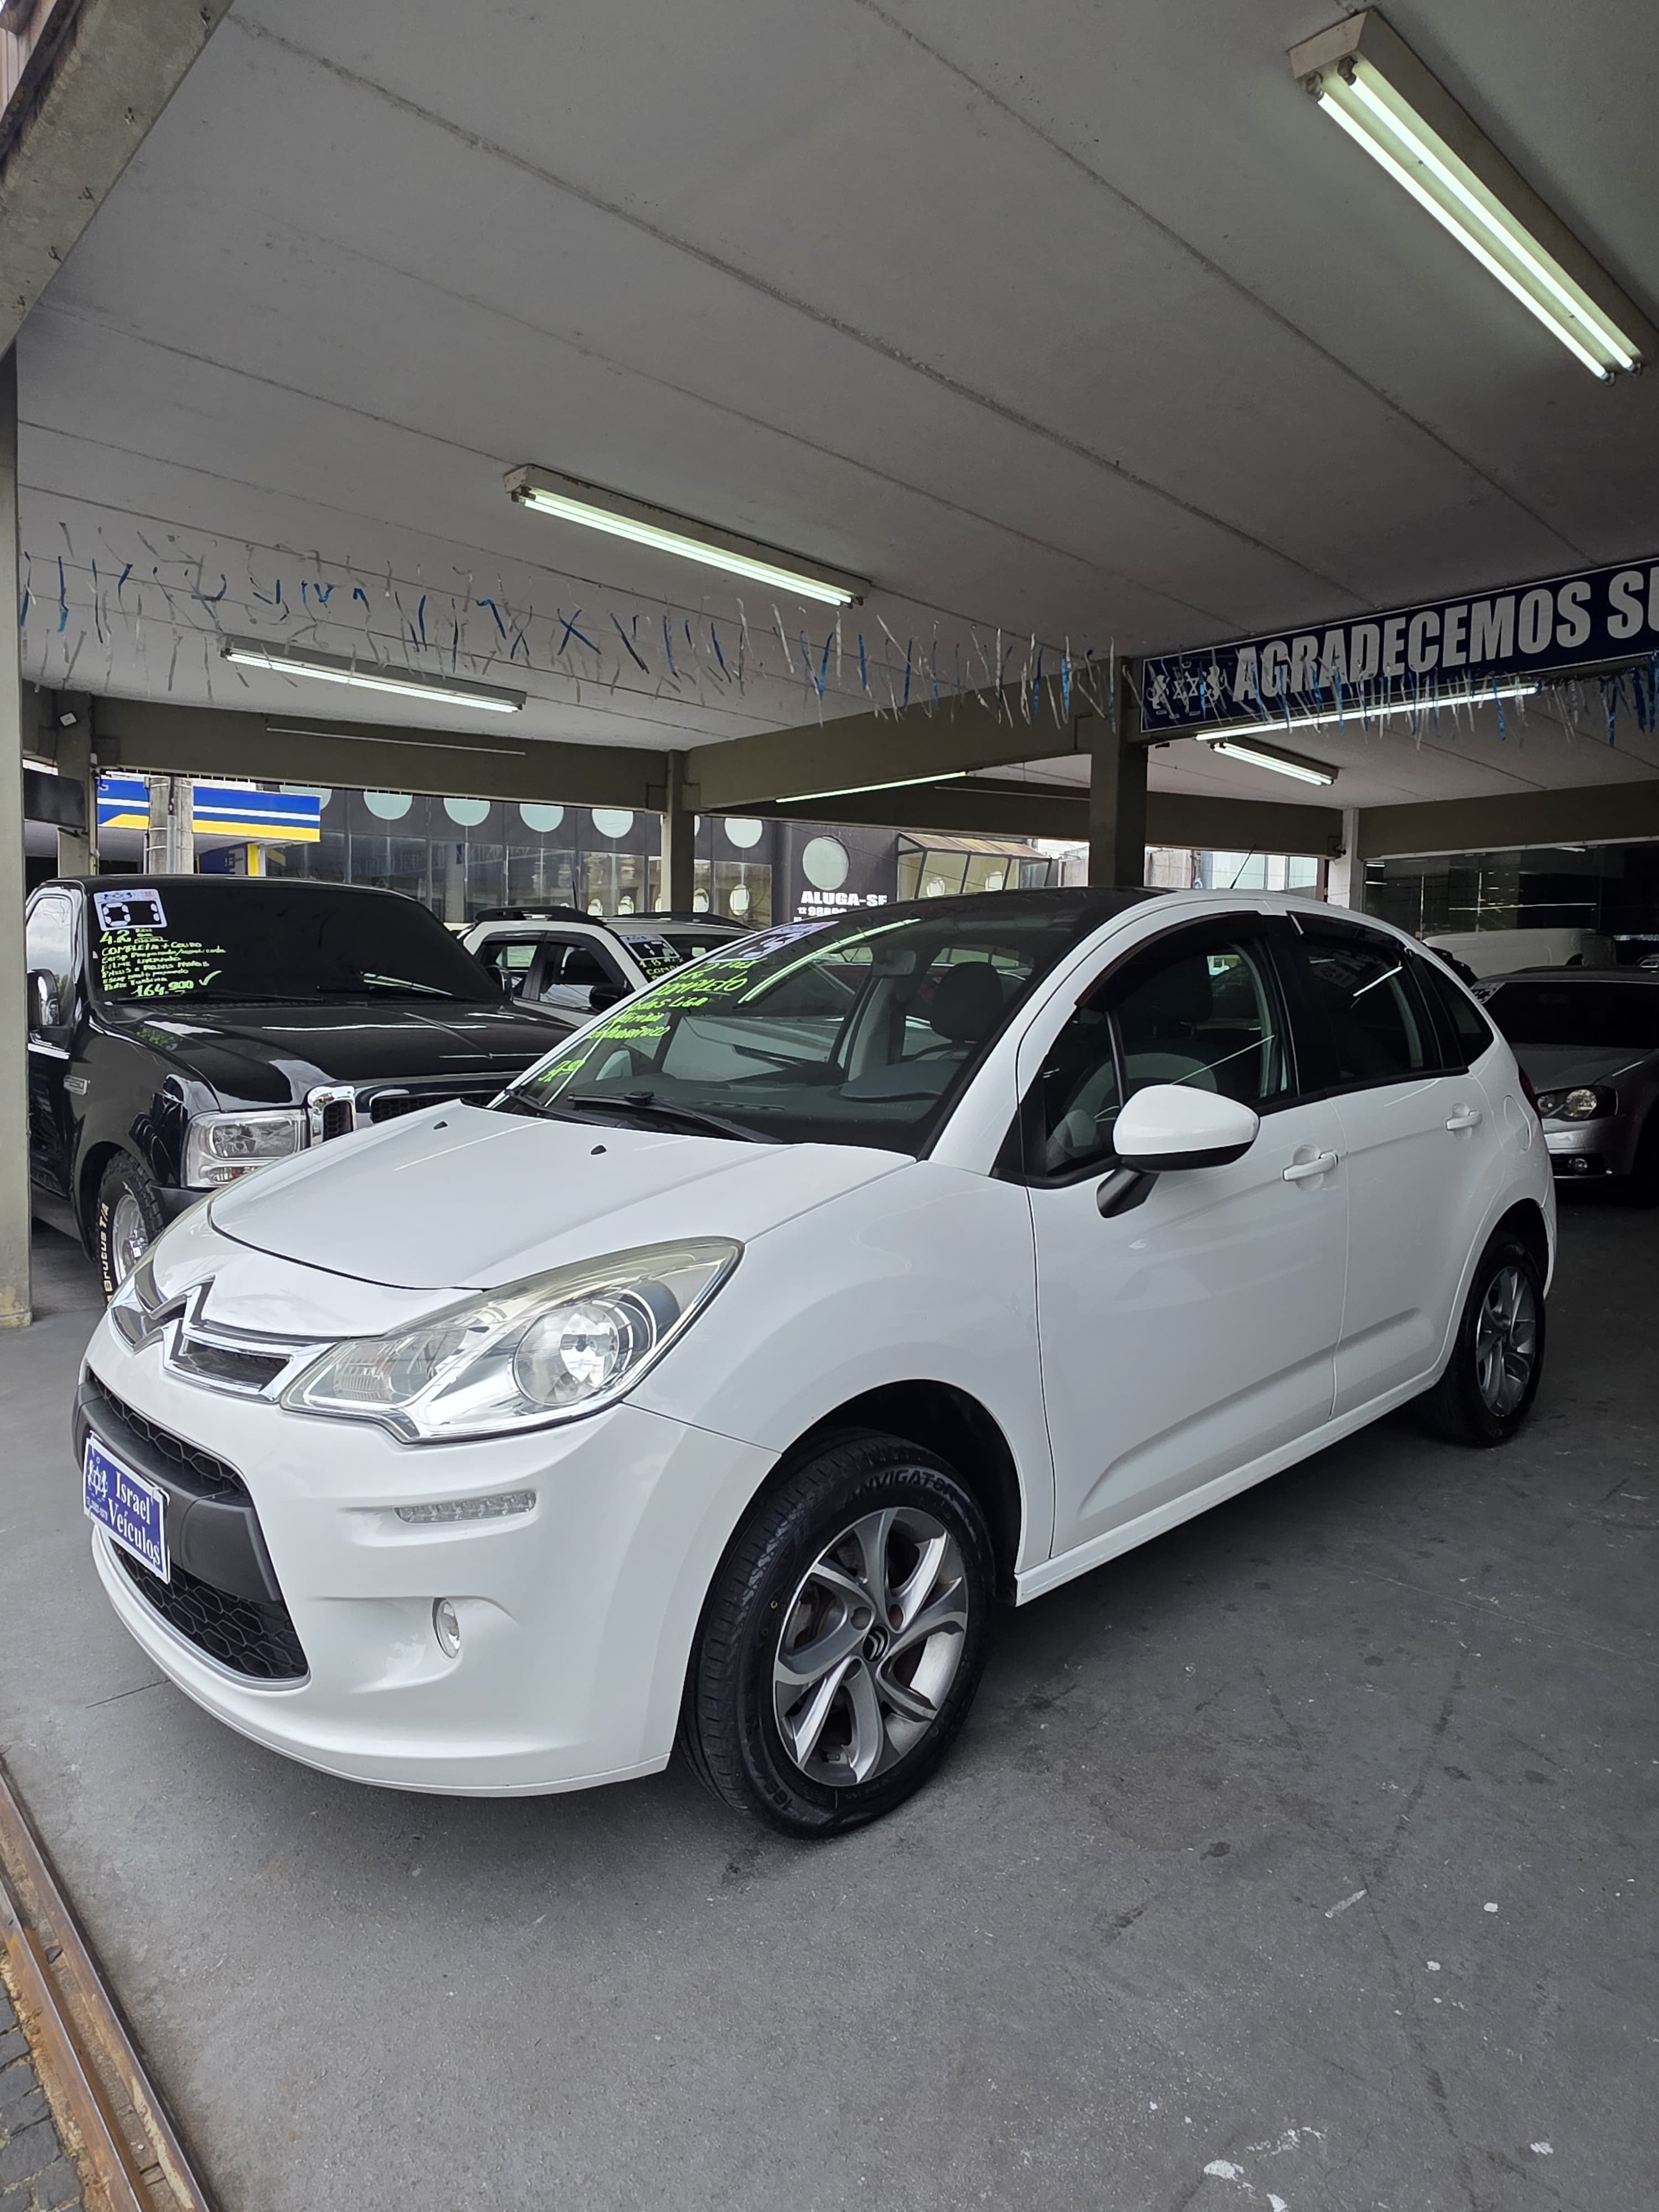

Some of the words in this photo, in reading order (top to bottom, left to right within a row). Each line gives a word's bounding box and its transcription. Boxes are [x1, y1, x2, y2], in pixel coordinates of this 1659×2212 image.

[1232, 581, 1591, 705] AGRADECEMOS
[100, 930, 132, 945] 4.2
[131, 979, 194, 997] 164.900
[116, 1471, 150, 1525] Israel
[108, 1498, 160, 1566] Veículos
